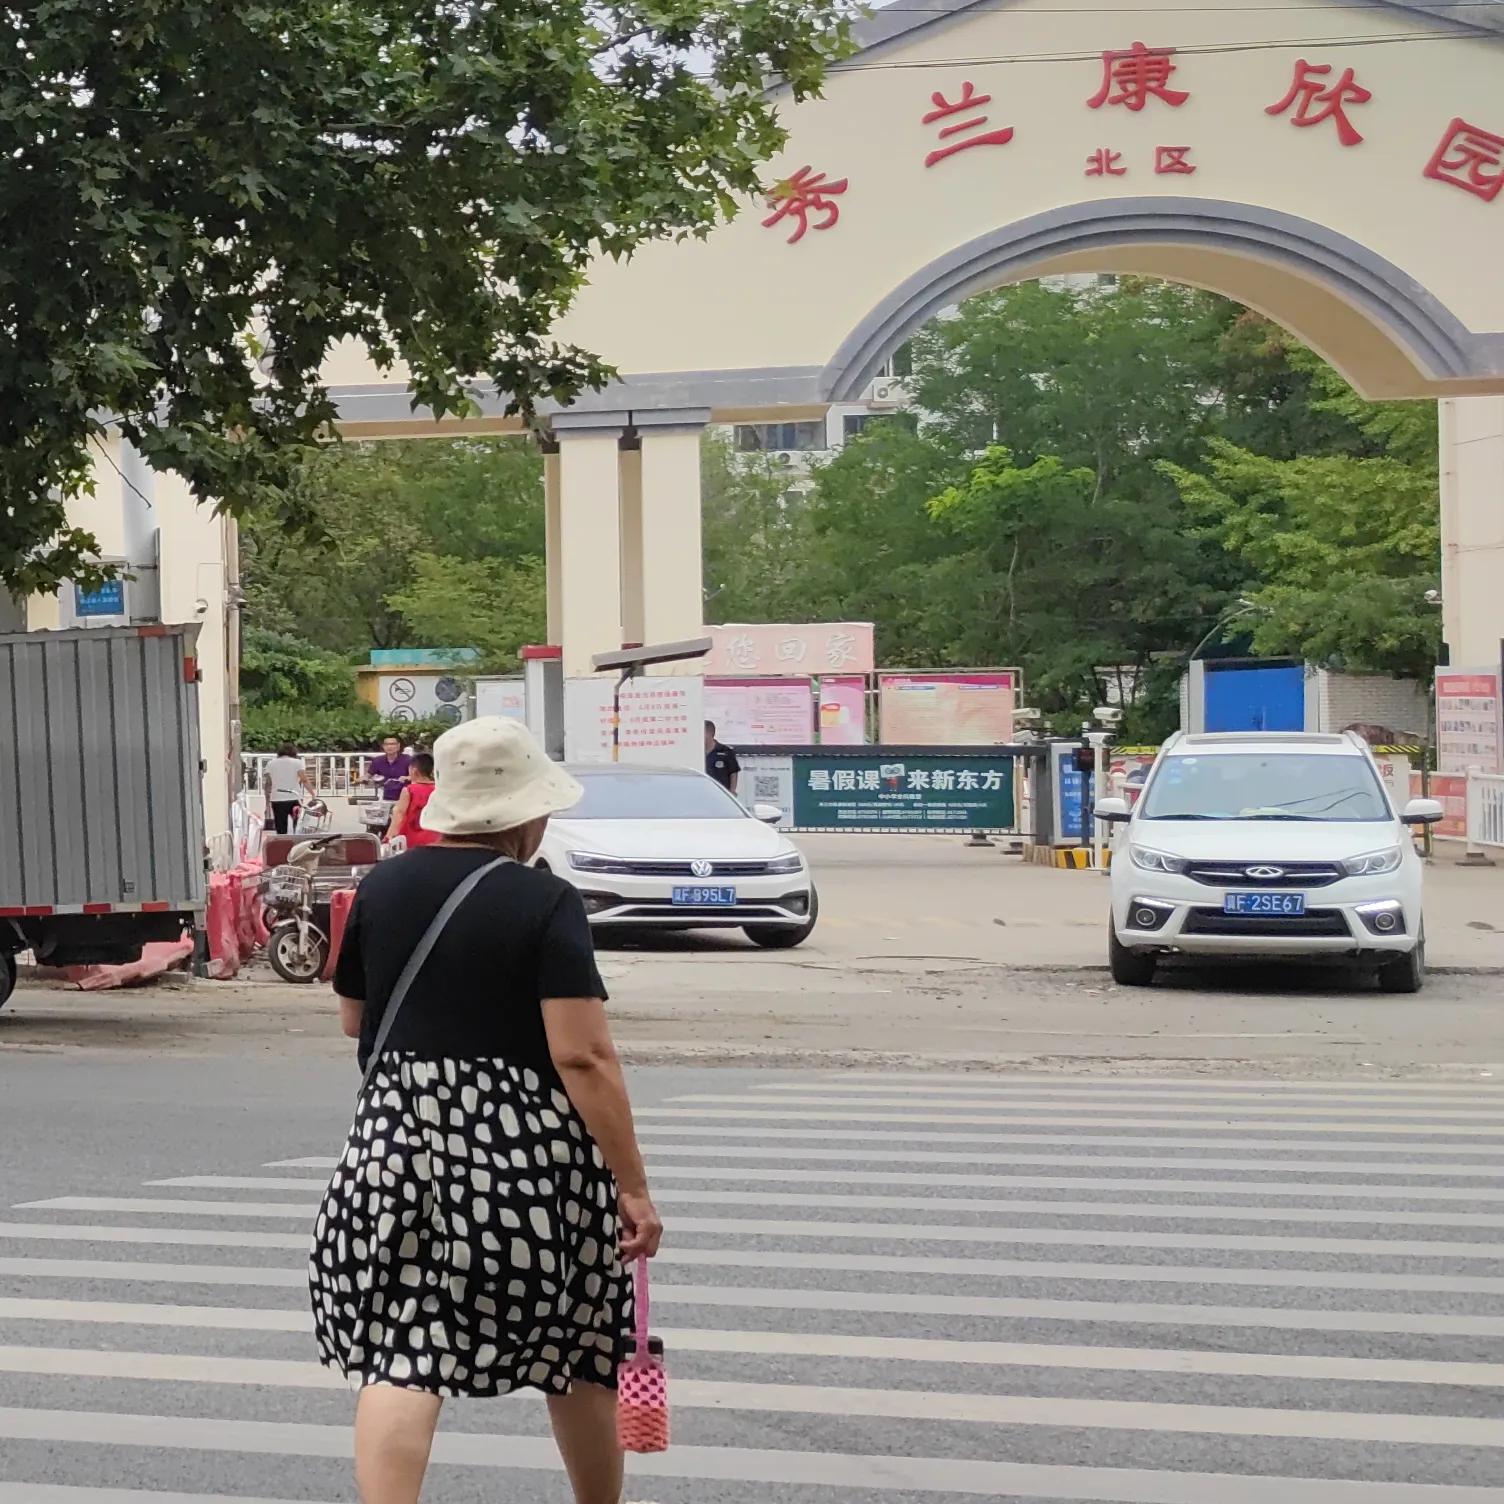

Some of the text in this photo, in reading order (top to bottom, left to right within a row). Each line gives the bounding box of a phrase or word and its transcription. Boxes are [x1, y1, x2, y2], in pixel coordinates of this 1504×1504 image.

[761, 41, 1504, 244] 秀兰康欣园
[1085, 146, 1197, 177] 北区
[808, 769, 1004, 791] 暑假课 来新东方
